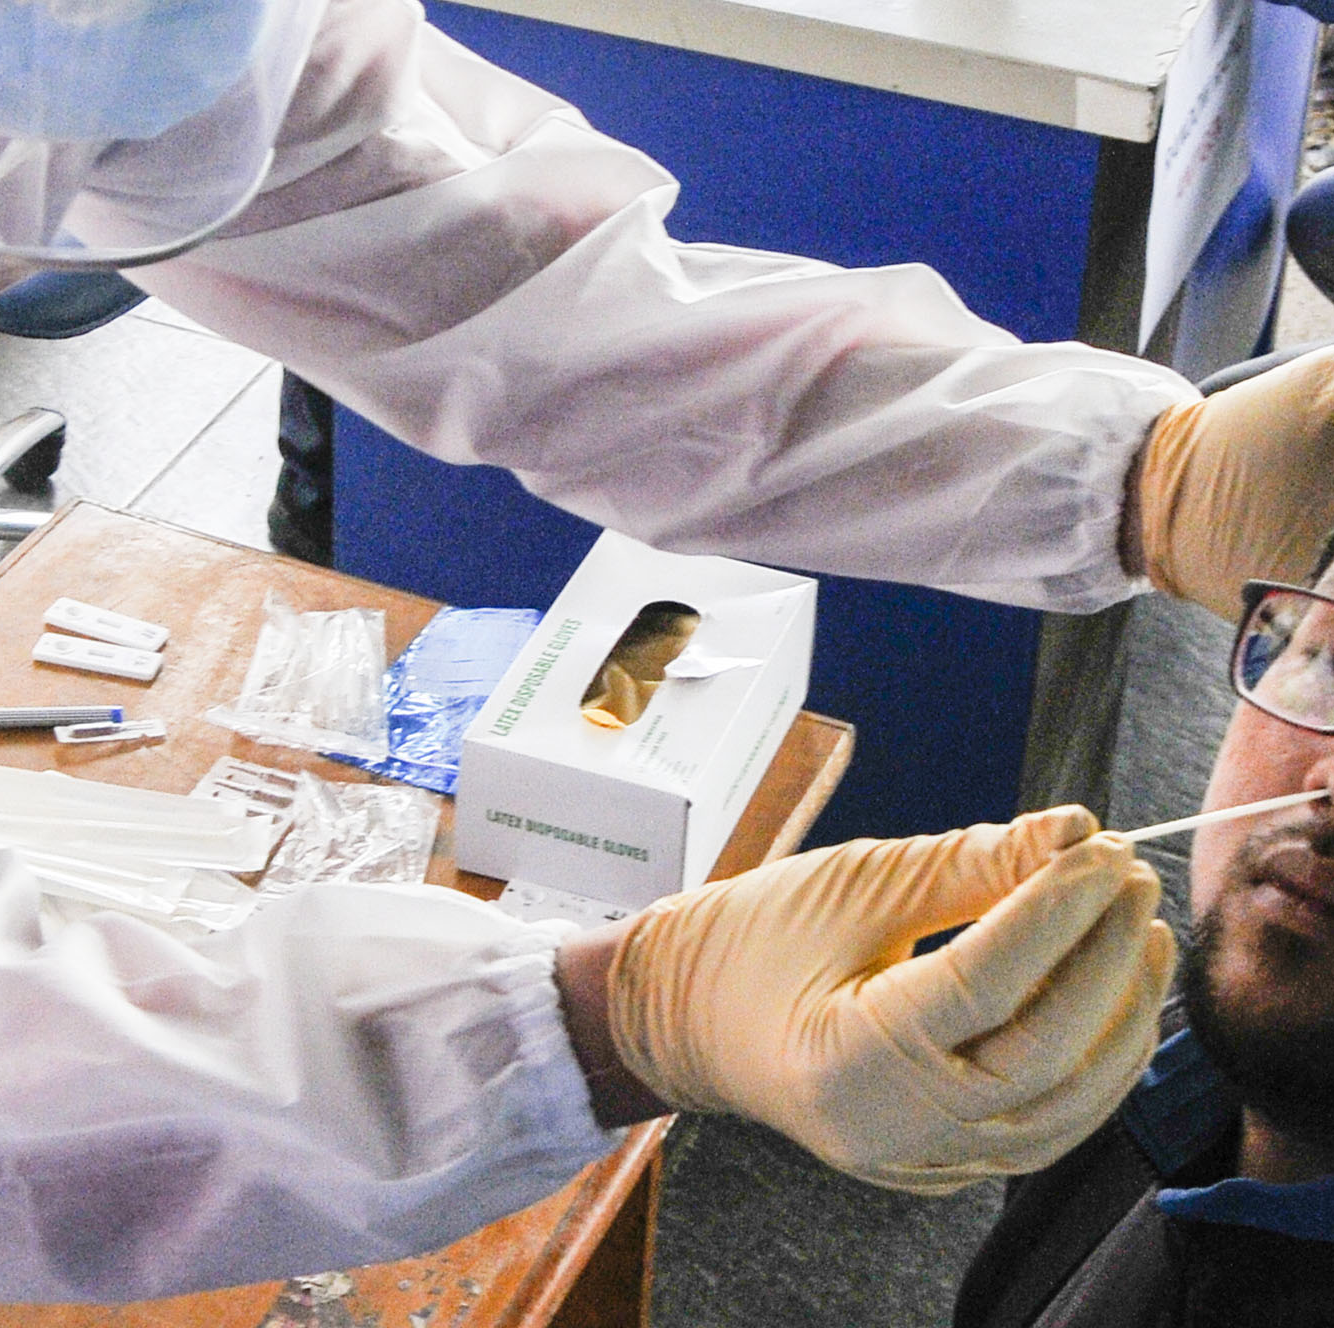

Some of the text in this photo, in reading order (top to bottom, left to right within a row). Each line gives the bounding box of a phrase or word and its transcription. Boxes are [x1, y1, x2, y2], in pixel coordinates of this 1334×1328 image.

[488, 618, 582, 737] LATEX DISPOSABLE GLOVES
[485, 808, 523, 829] LATEX
